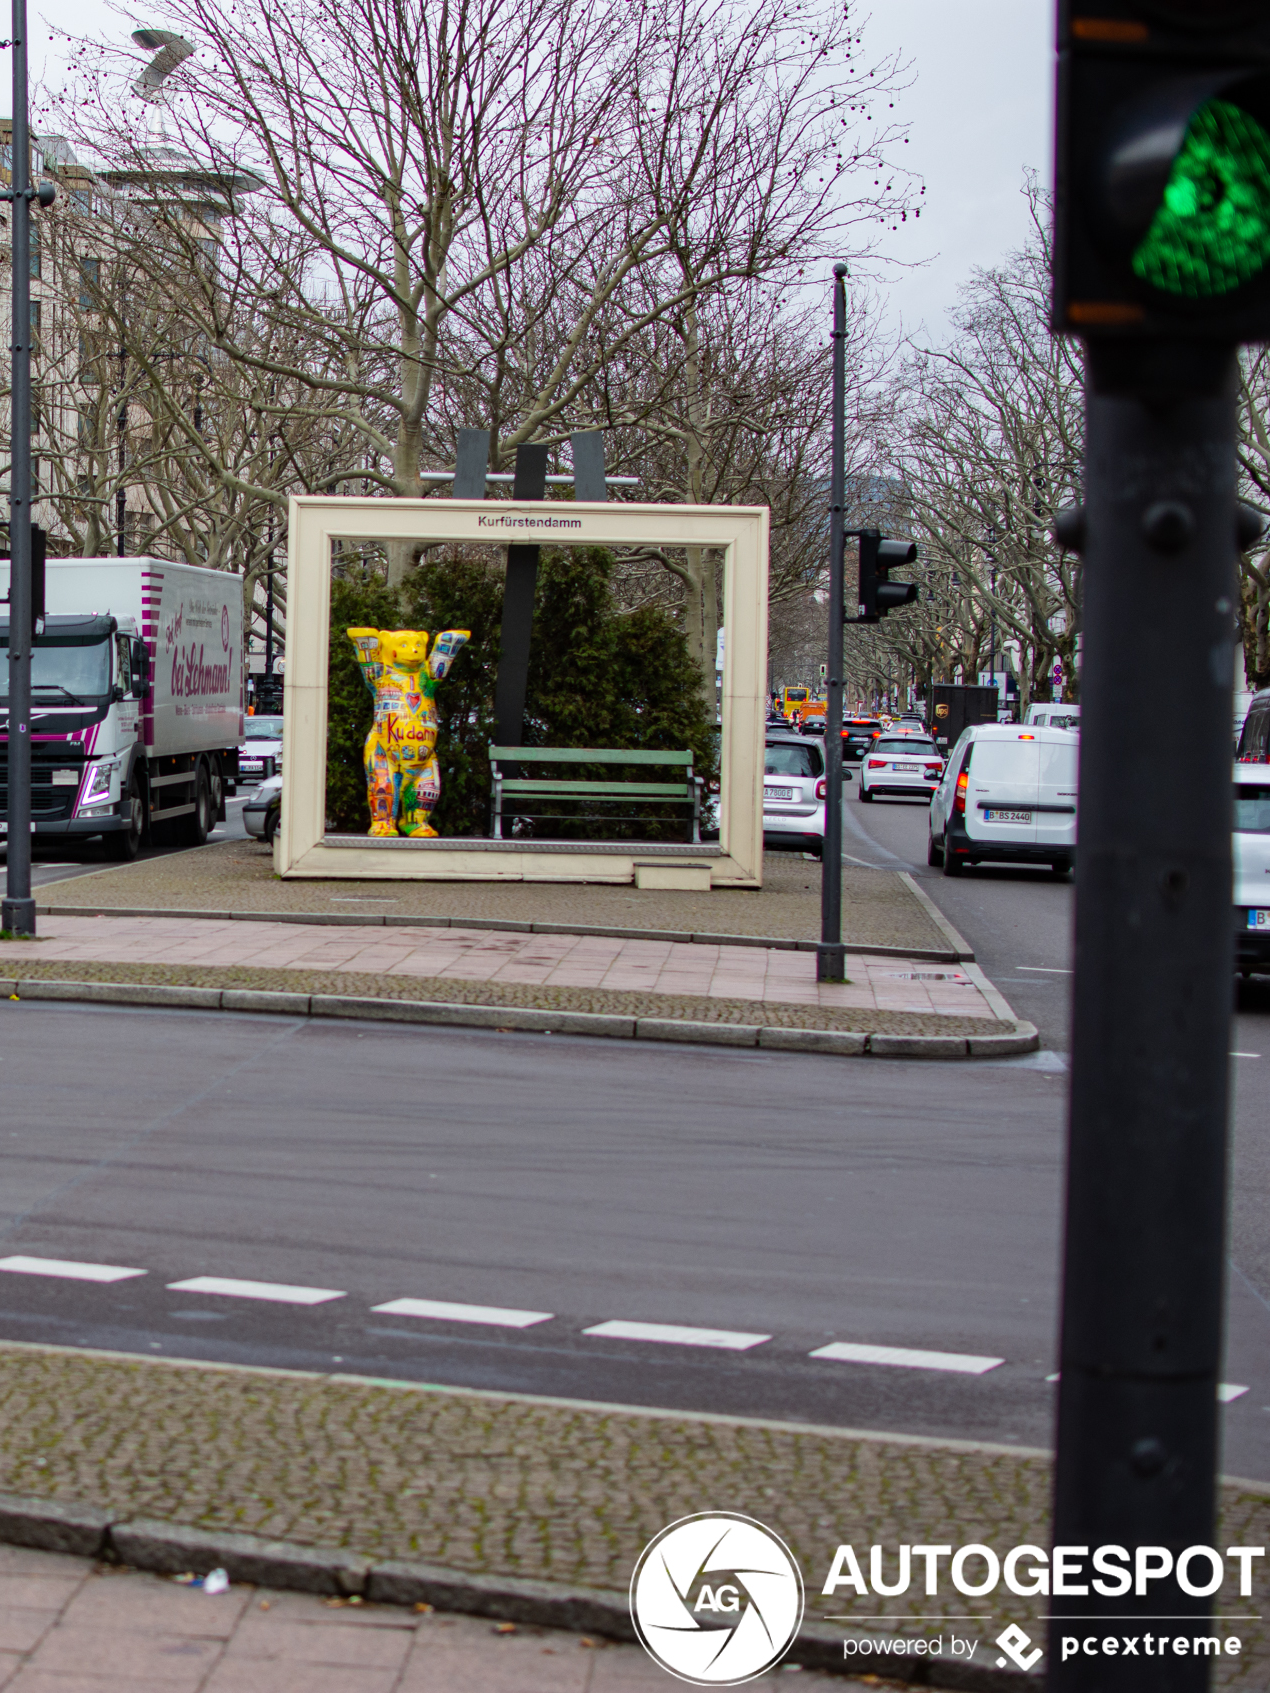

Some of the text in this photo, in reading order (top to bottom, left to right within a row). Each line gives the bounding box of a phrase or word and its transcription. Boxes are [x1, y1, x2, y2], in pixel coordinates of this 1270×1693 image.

[478, 516, 582, 528] Kurfürstendamm
[989, 811, 1030, 820] B BS 2440
[1256, 911, 1265, 925] B
